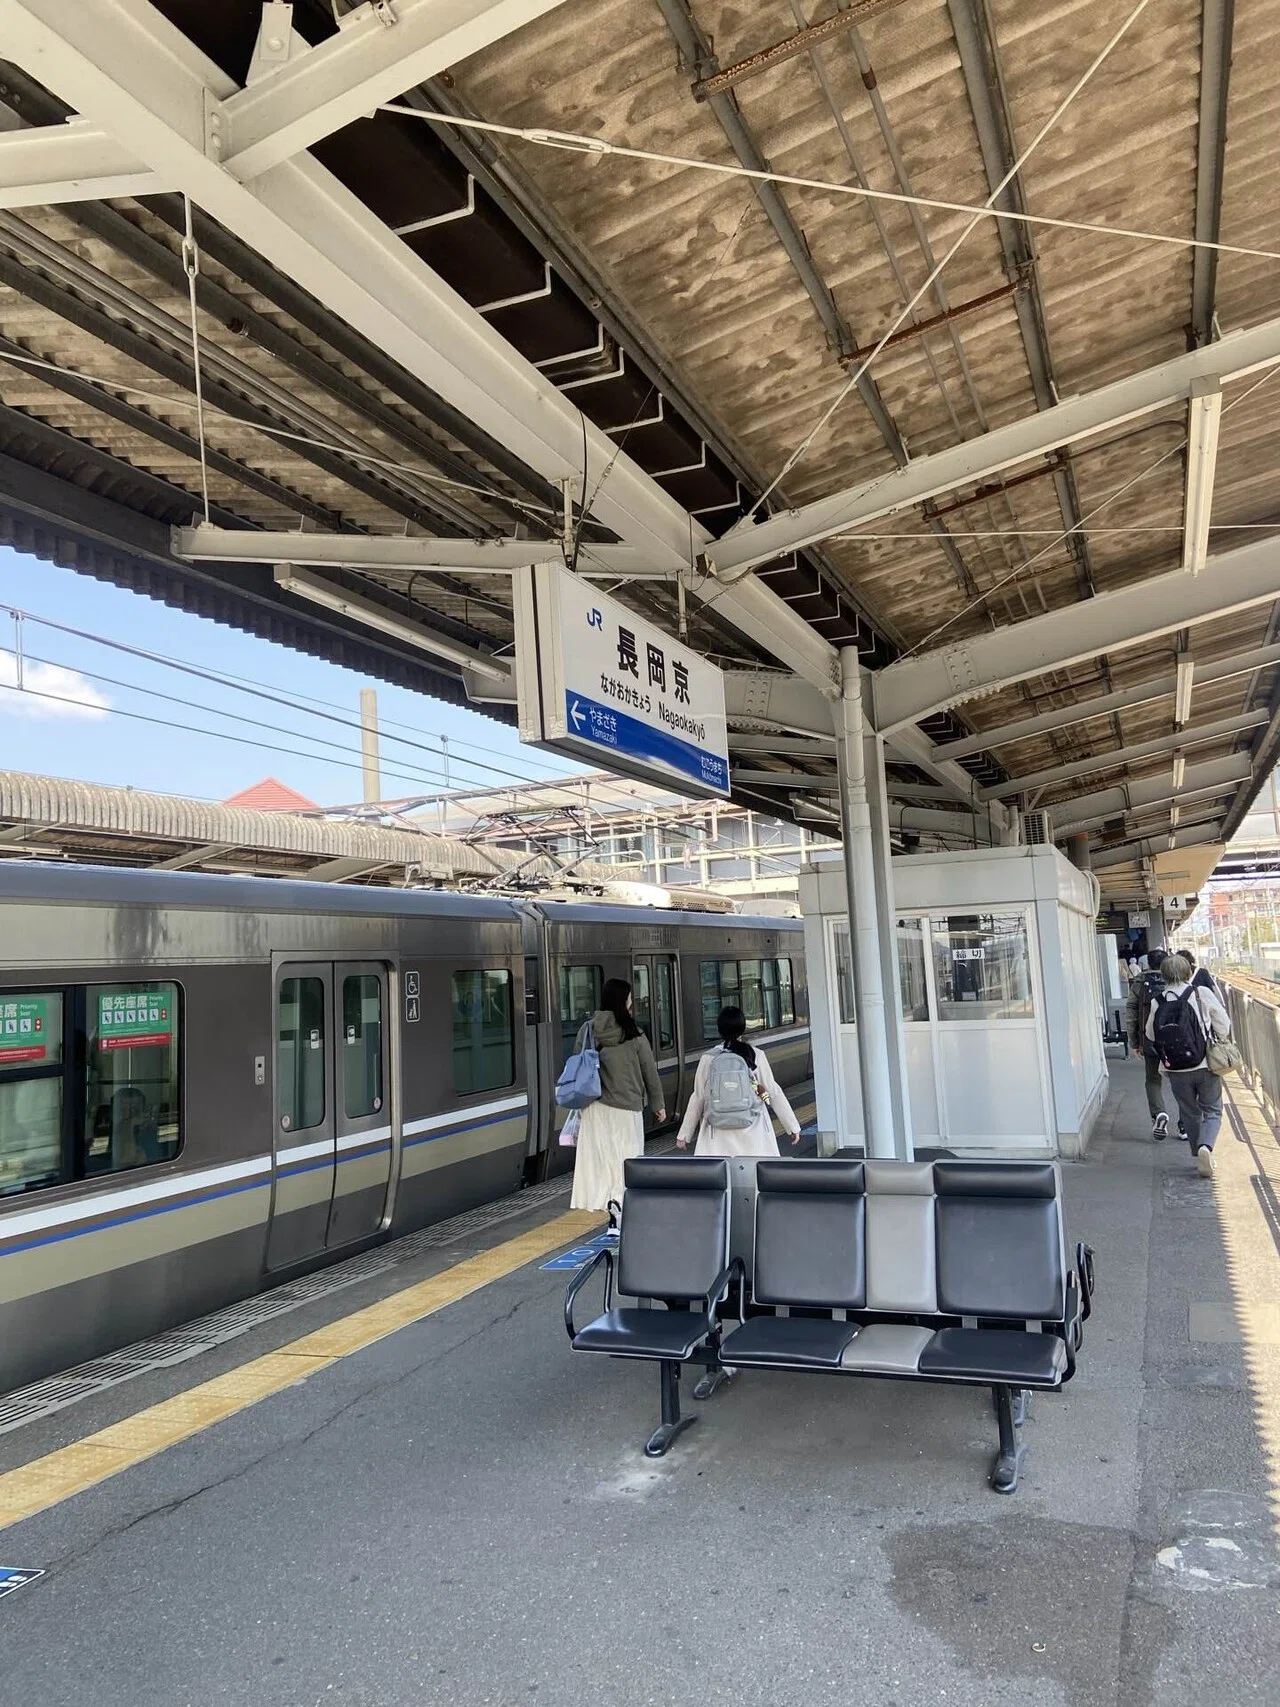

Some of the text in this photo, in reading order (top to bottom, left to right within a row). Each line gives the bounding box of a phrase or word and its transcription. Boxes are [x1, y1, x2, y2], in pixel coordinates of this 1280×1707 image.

[586, 608, 603, 631] JR
[617, 625, 691, 705] 長岡京
[600, 672, 652, 714] ながおかきょう
[589, 707, 618, 732] やまざき
[591, 725, 618, 745] Yamazaki
[1170, 896, 1180, 909] 4
[102, 995, 148, 1011] 優先座席
